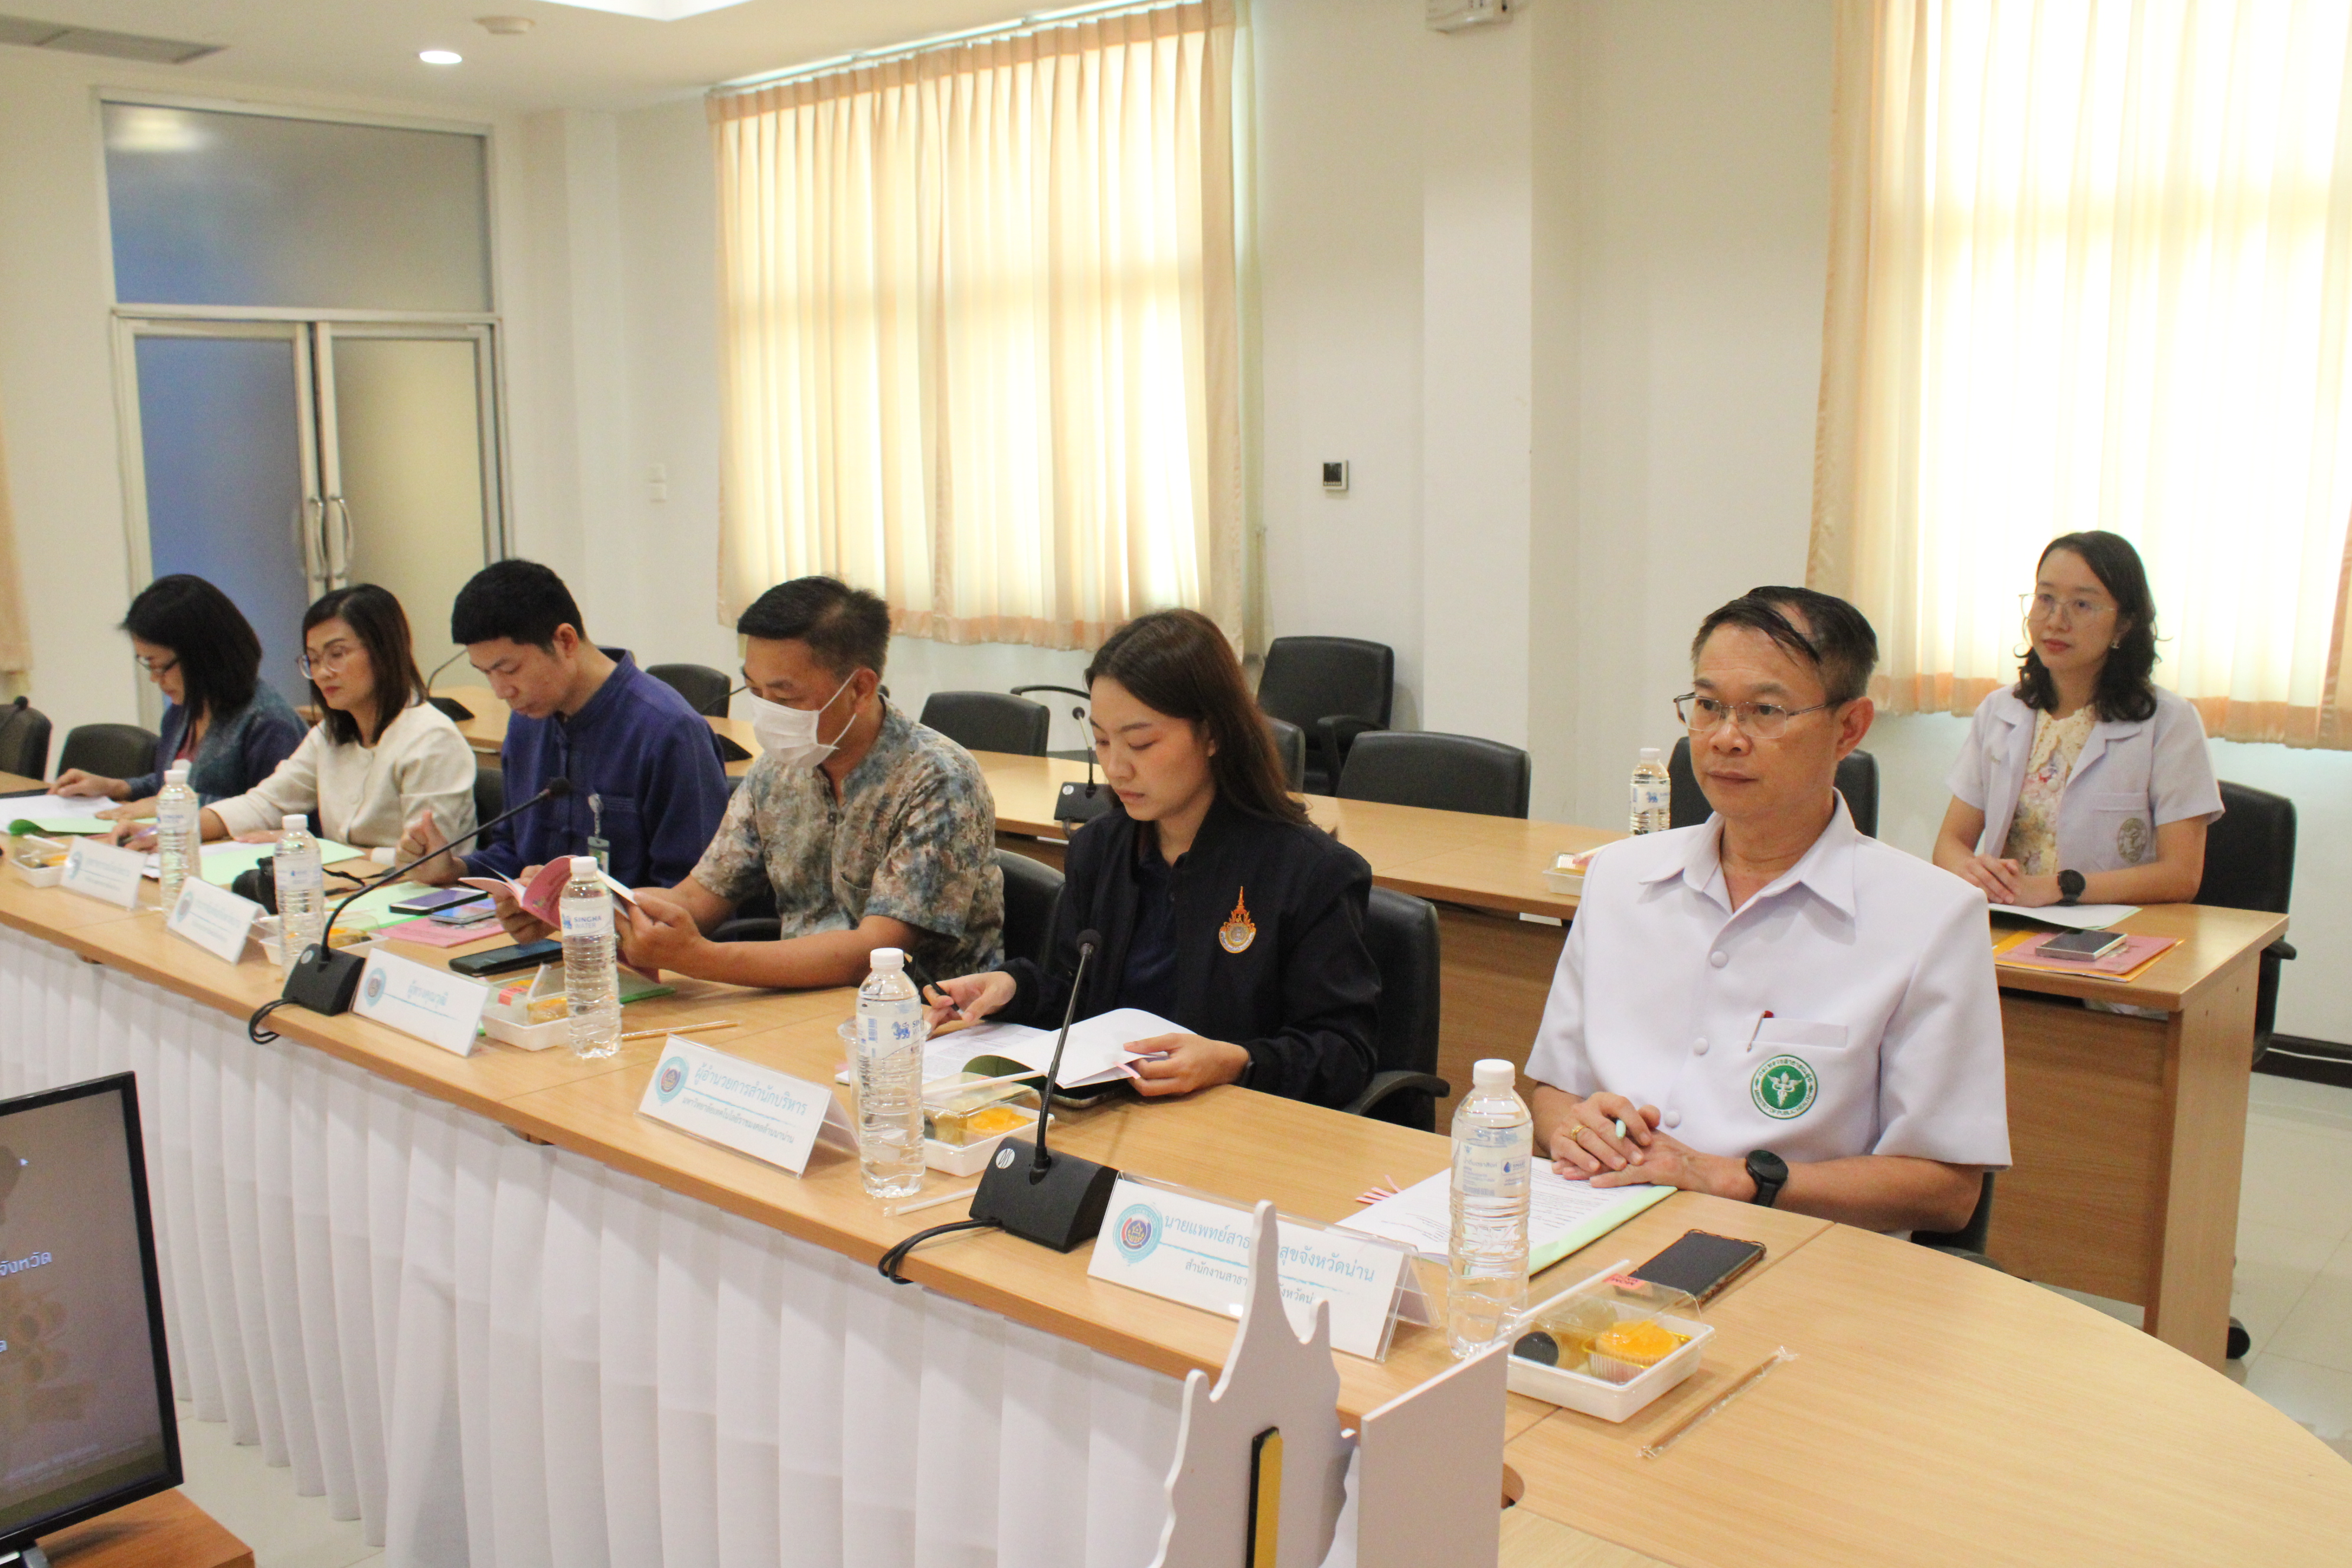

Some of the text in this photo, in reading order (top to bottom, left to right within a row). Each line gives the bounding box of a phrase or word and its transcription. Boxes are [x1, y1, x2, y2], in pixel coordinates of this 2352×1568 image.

[694, 1063, 808, 1115] ผู้อำนวยการสำนักบริหาร
[1165, 1215, 1375, 1282] นายแพทย์สาธสุขจังหวัดน่าน
